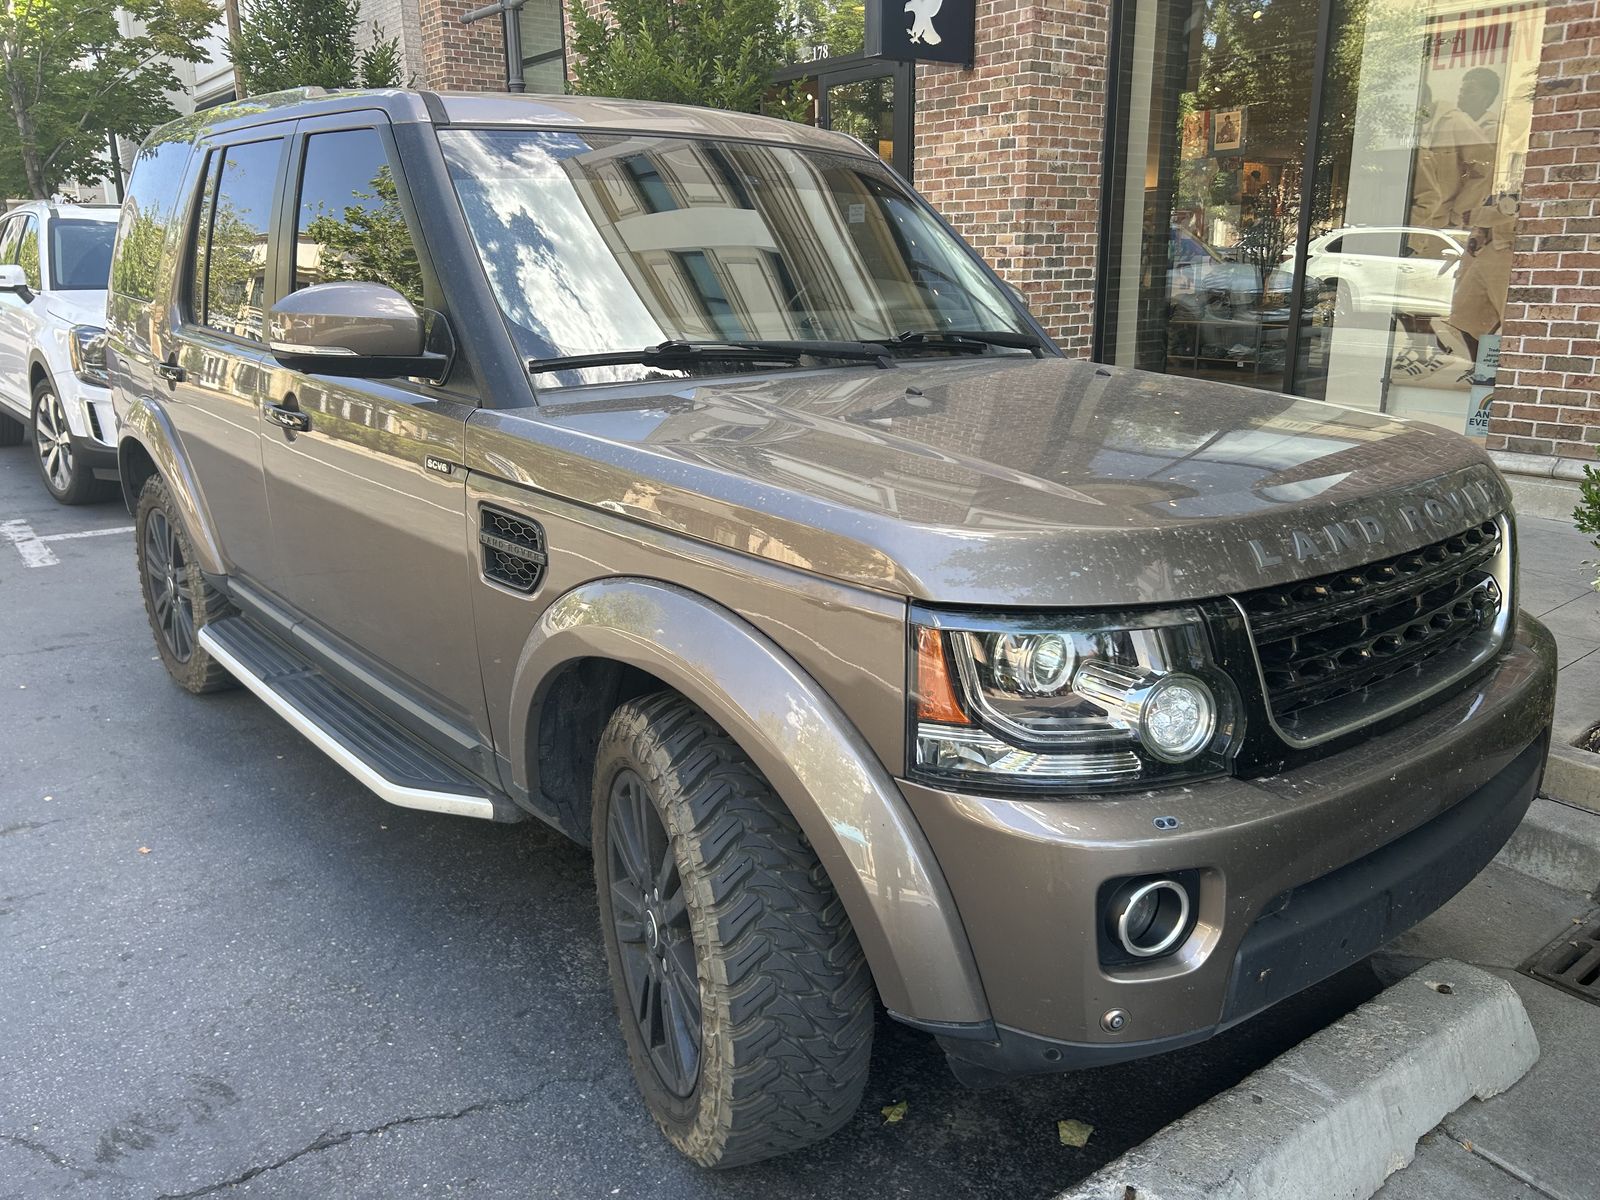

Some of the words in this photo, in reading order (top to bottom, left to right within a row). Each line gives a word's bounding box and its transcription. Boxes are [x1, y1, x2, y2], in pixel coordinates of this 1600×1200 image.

[812, 44, 829, 60] 178
[1468, 417, 1488, 427] EVE
[427, 459, 447, 472] SCV6
[481, 534, 504, 548] LAND
[1248, 516, 1386, 568] LAND
